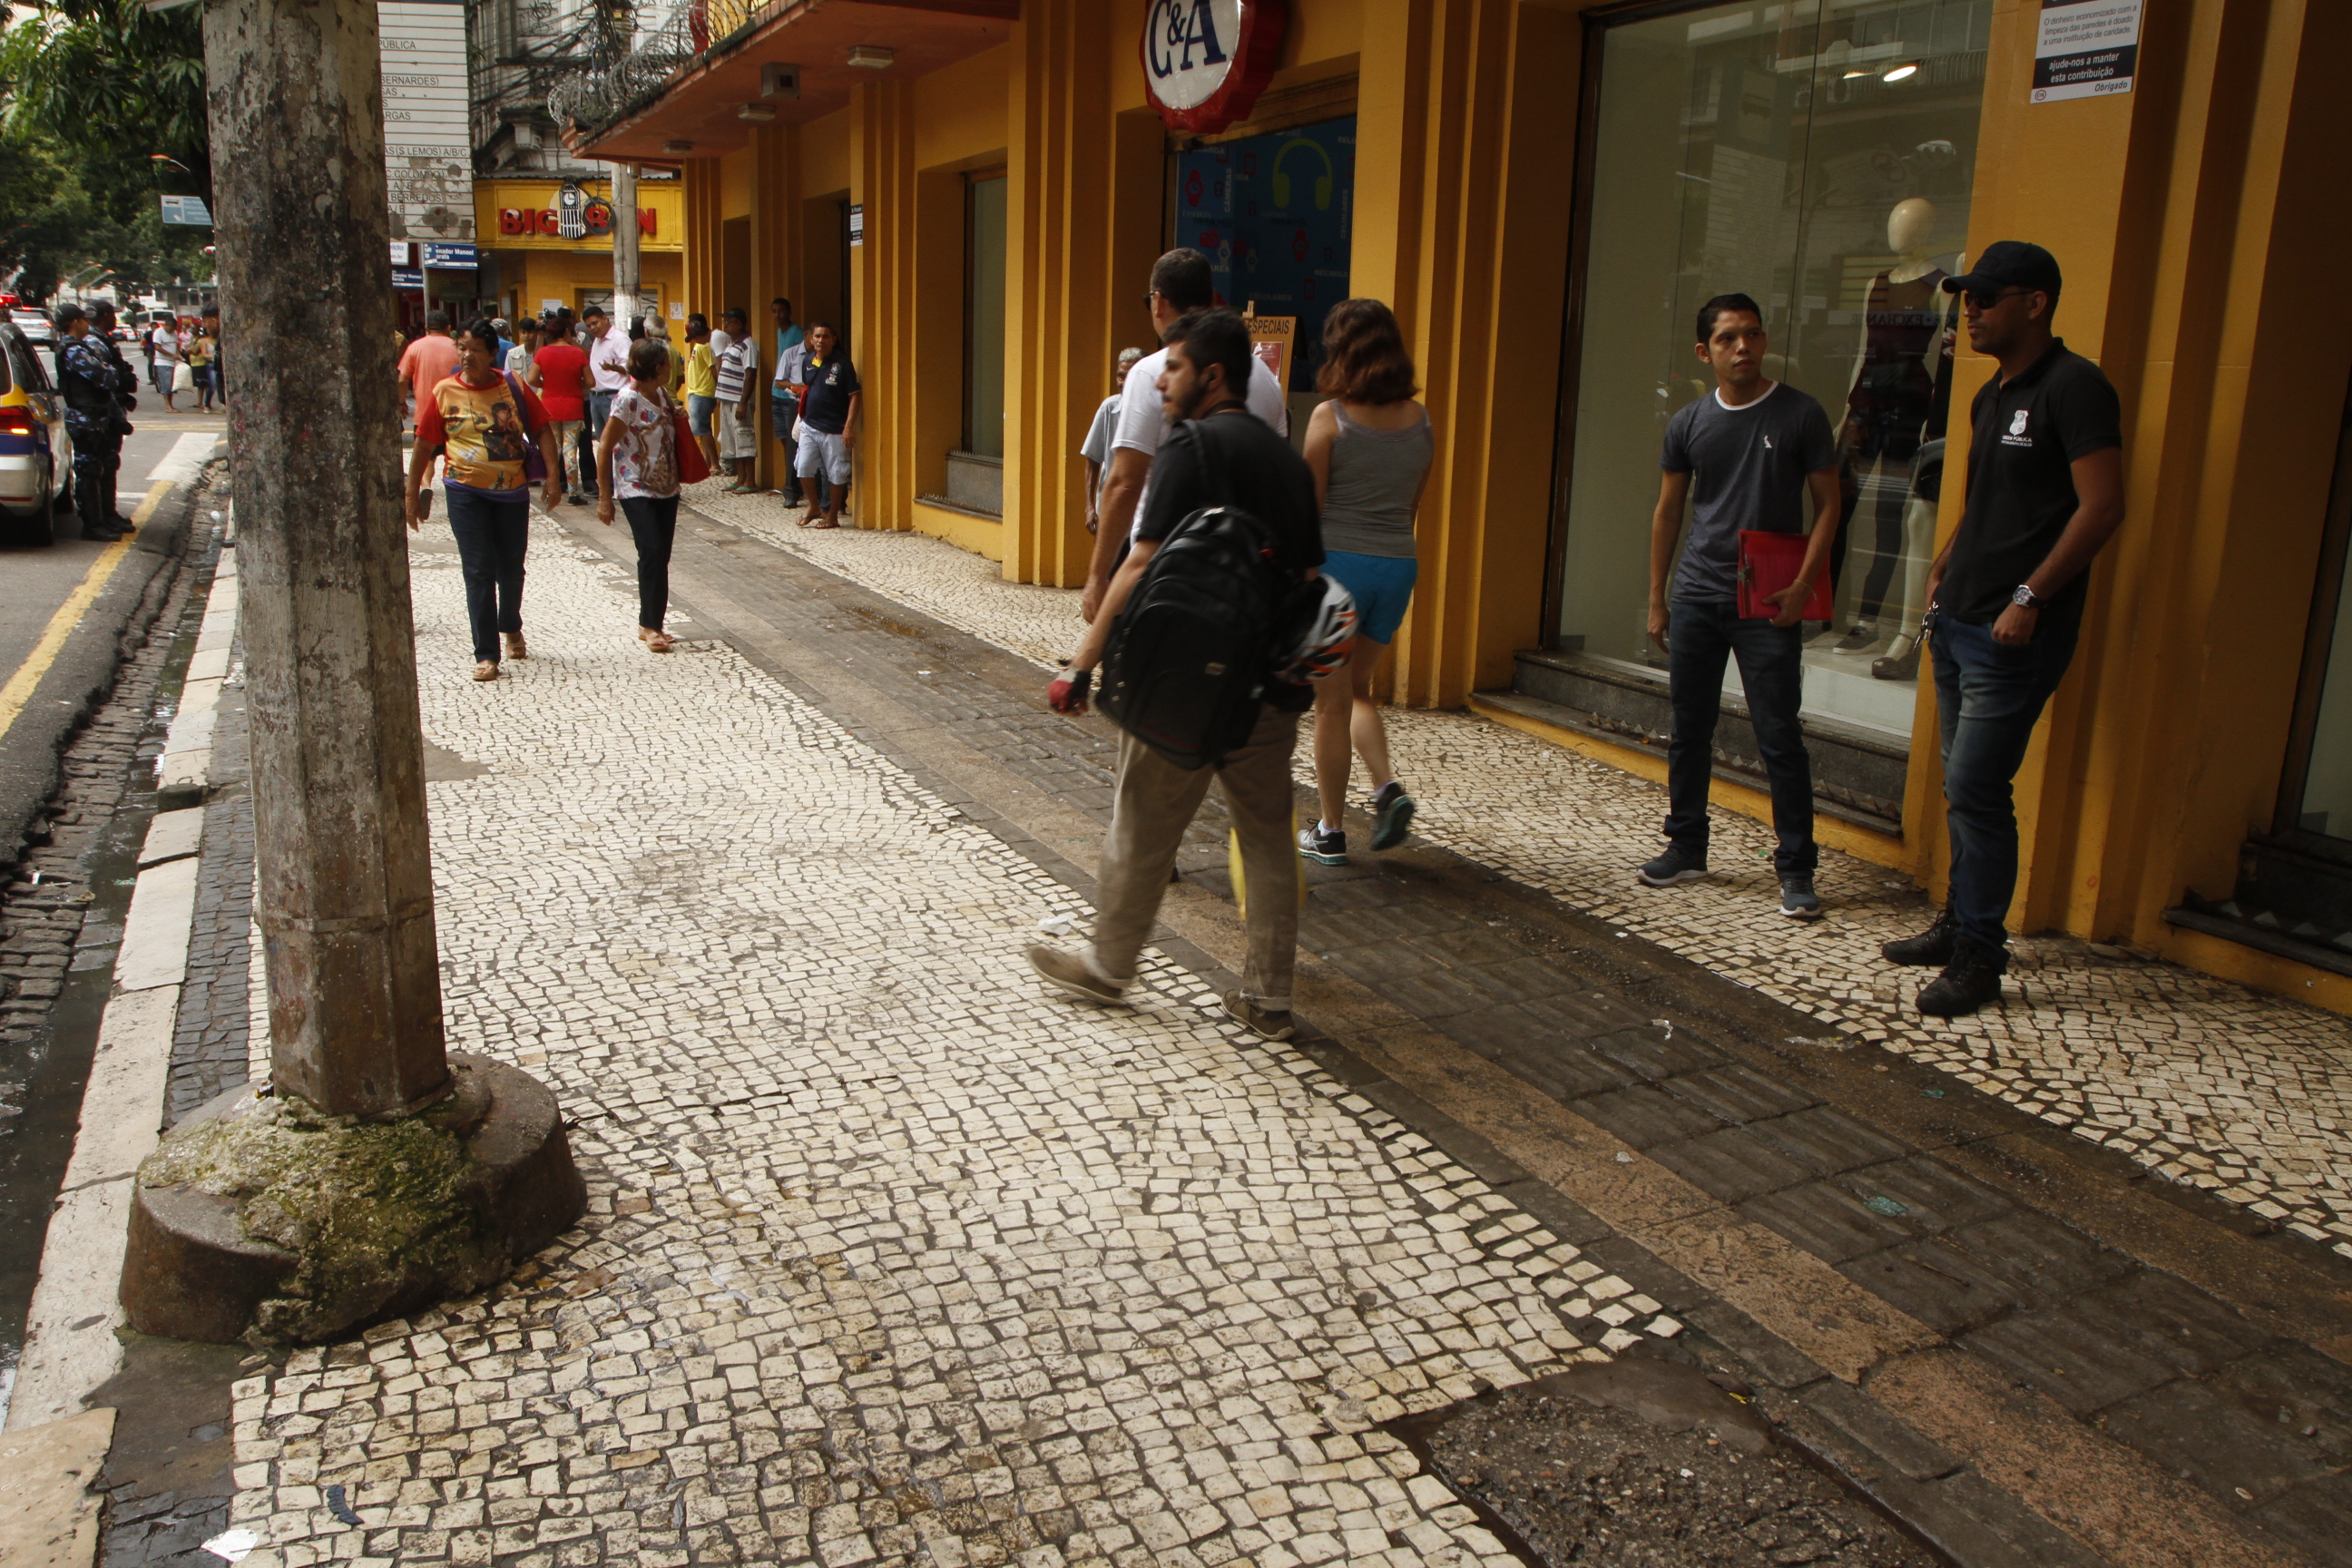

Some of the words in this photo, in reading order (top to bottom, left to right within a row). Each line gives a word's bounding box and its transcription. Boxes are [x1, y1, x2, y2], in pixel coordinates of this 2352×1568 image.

[2051, 15, 2074, 25] dinheiro
[2075, 7, 2116, 20] economizado
[2118, 6, 2131, 15] com
[2045, 25, 2068, 36] limpeza
[2069, 24, 2081, 32] das
[2082, 20, 2107, 31] paredes
[2113, 15, 2133, 25] doado
[1149, 0, 1227, 78] C&A
[2049, 36, 2062, 45] uma
[2063, 31, 2093, 43] instituição
[2094, 29, 2102, 38] de
[2049, 57, 2084, 73] ajude-nos
[2092, 53, 2120, 64] manter
[2050, 73, 2065, 83] esta
[2067, 66, 2114, 81] contribuição
[2094, 81, 2128, 92] Obrigado
[443, 148, 466, 157] A/B/C
[500, 208, 559, 236] BIG
[585, 207, 657, 236] BN
[1248, 319, 1289, 334] ESPECIAIS
